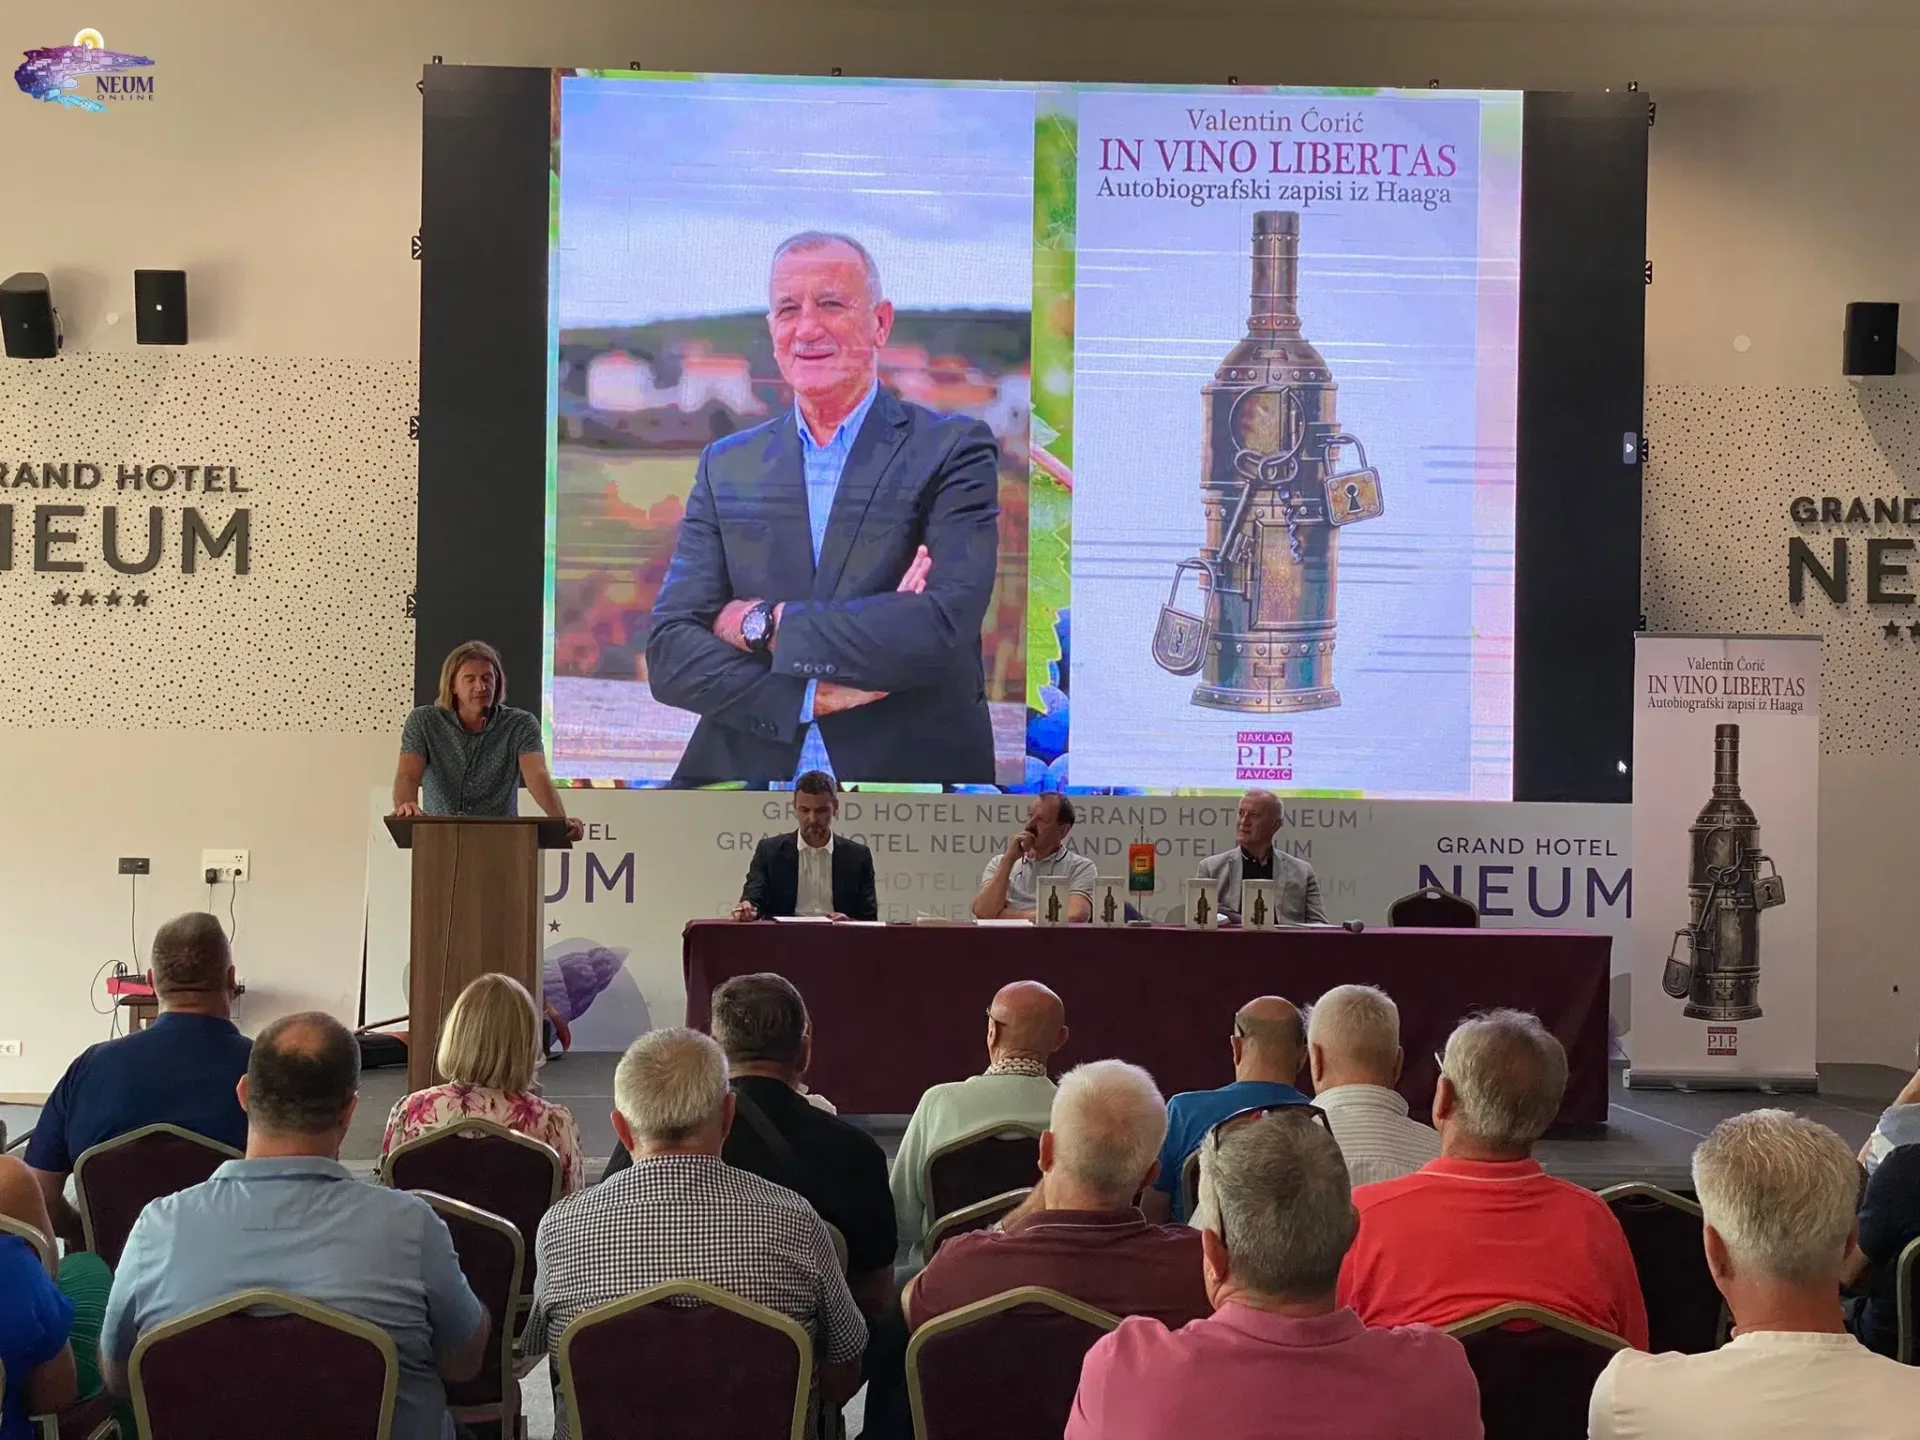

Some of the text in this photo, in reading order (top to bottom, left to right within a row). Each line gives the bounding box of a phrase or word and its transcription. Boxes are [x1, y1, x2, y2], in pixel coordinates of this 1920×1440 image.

[1186, 106, 1364, 133] Valentin Ćorić
[1099, 138, 1457, 177] IN VINO LIBERTAS
[1097, 176, 1452, 211] Autobiografski zapisi iz Haaga
[117, 464, 249, 493] HOTEL
[0, 503, 249, 575] EUM
[1789, 536, 1916, 604] NE
[1687, 657, 1734, 671] Valentin
[1648, 674, 1805, 697] IN VINO LIBERTAS
[1647, 695, 1803, 715] Autobiografski zapisi iz Haaga
[1238, 732, 1291, 743] NAKLADA
[1237, 745, 1292, 766] P.I.P.
[874, 803, 966, 823] HOTEL
[976, 804, 1032, 823] NEU
[1074, 806, 1168, 826] GRAND
[1179, 807, 1236, 827] HOT
[1283, 809, 1357, 828] NEUM
[930, 834, 1008, 854] NEUM
[1066, 836, 1122, 856] AND
[1437, 837, 1618, 856] GRAND HOTEL
[1419, 864, 1633, 919] NEUM
